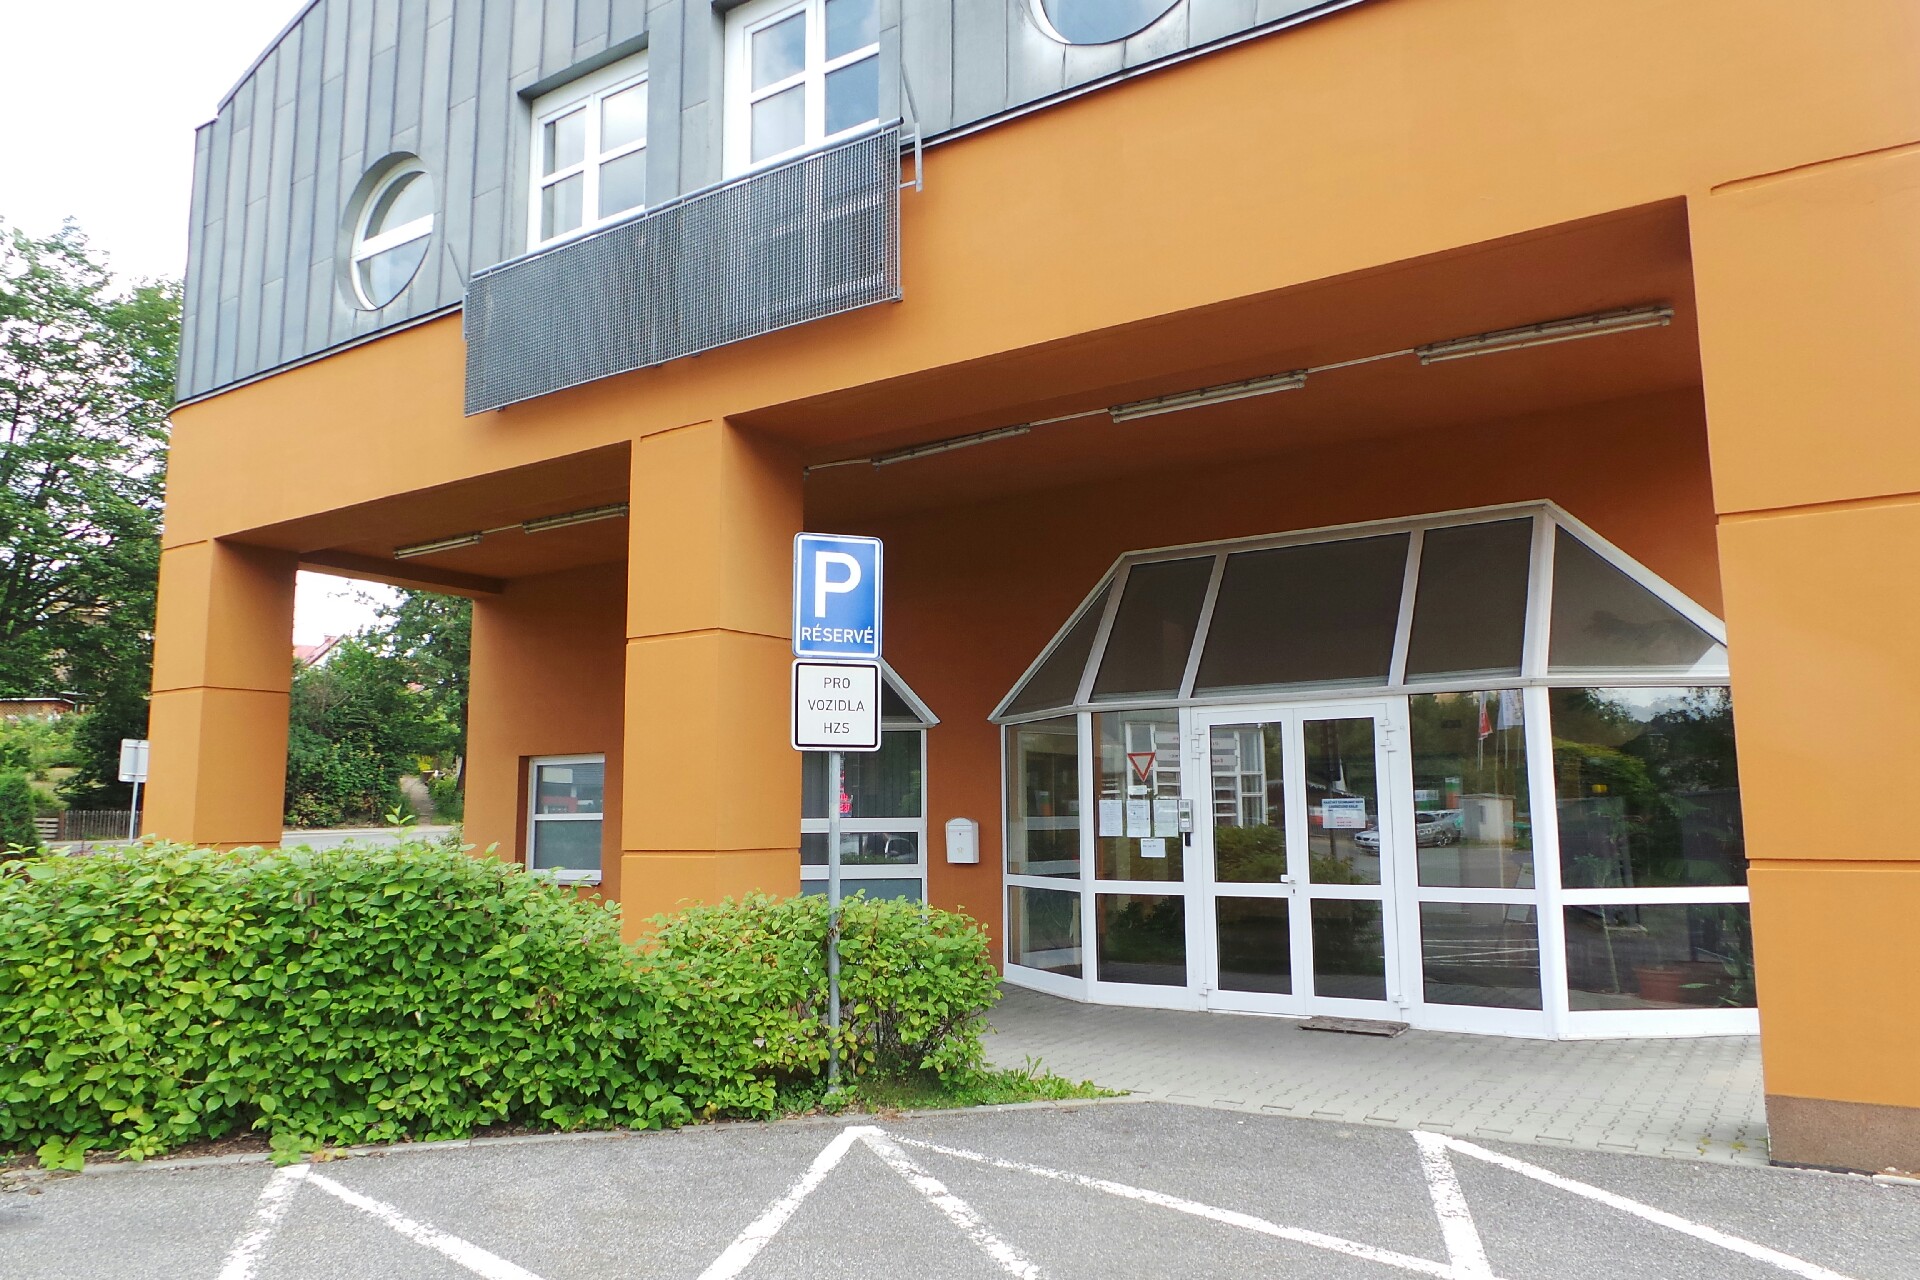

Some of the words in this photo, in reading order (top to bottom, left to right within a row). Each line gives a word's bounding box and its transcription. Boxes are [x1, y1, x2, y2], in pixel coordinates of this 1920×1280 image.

[815, 551, 862, 618] P
[801, 623, 874, 644] RÉSERVÉ
[823, 677, 851, 689] PRO
[807, 699, 865, 712] VOZIDLA
[823, 722, 850, 734] HZS
